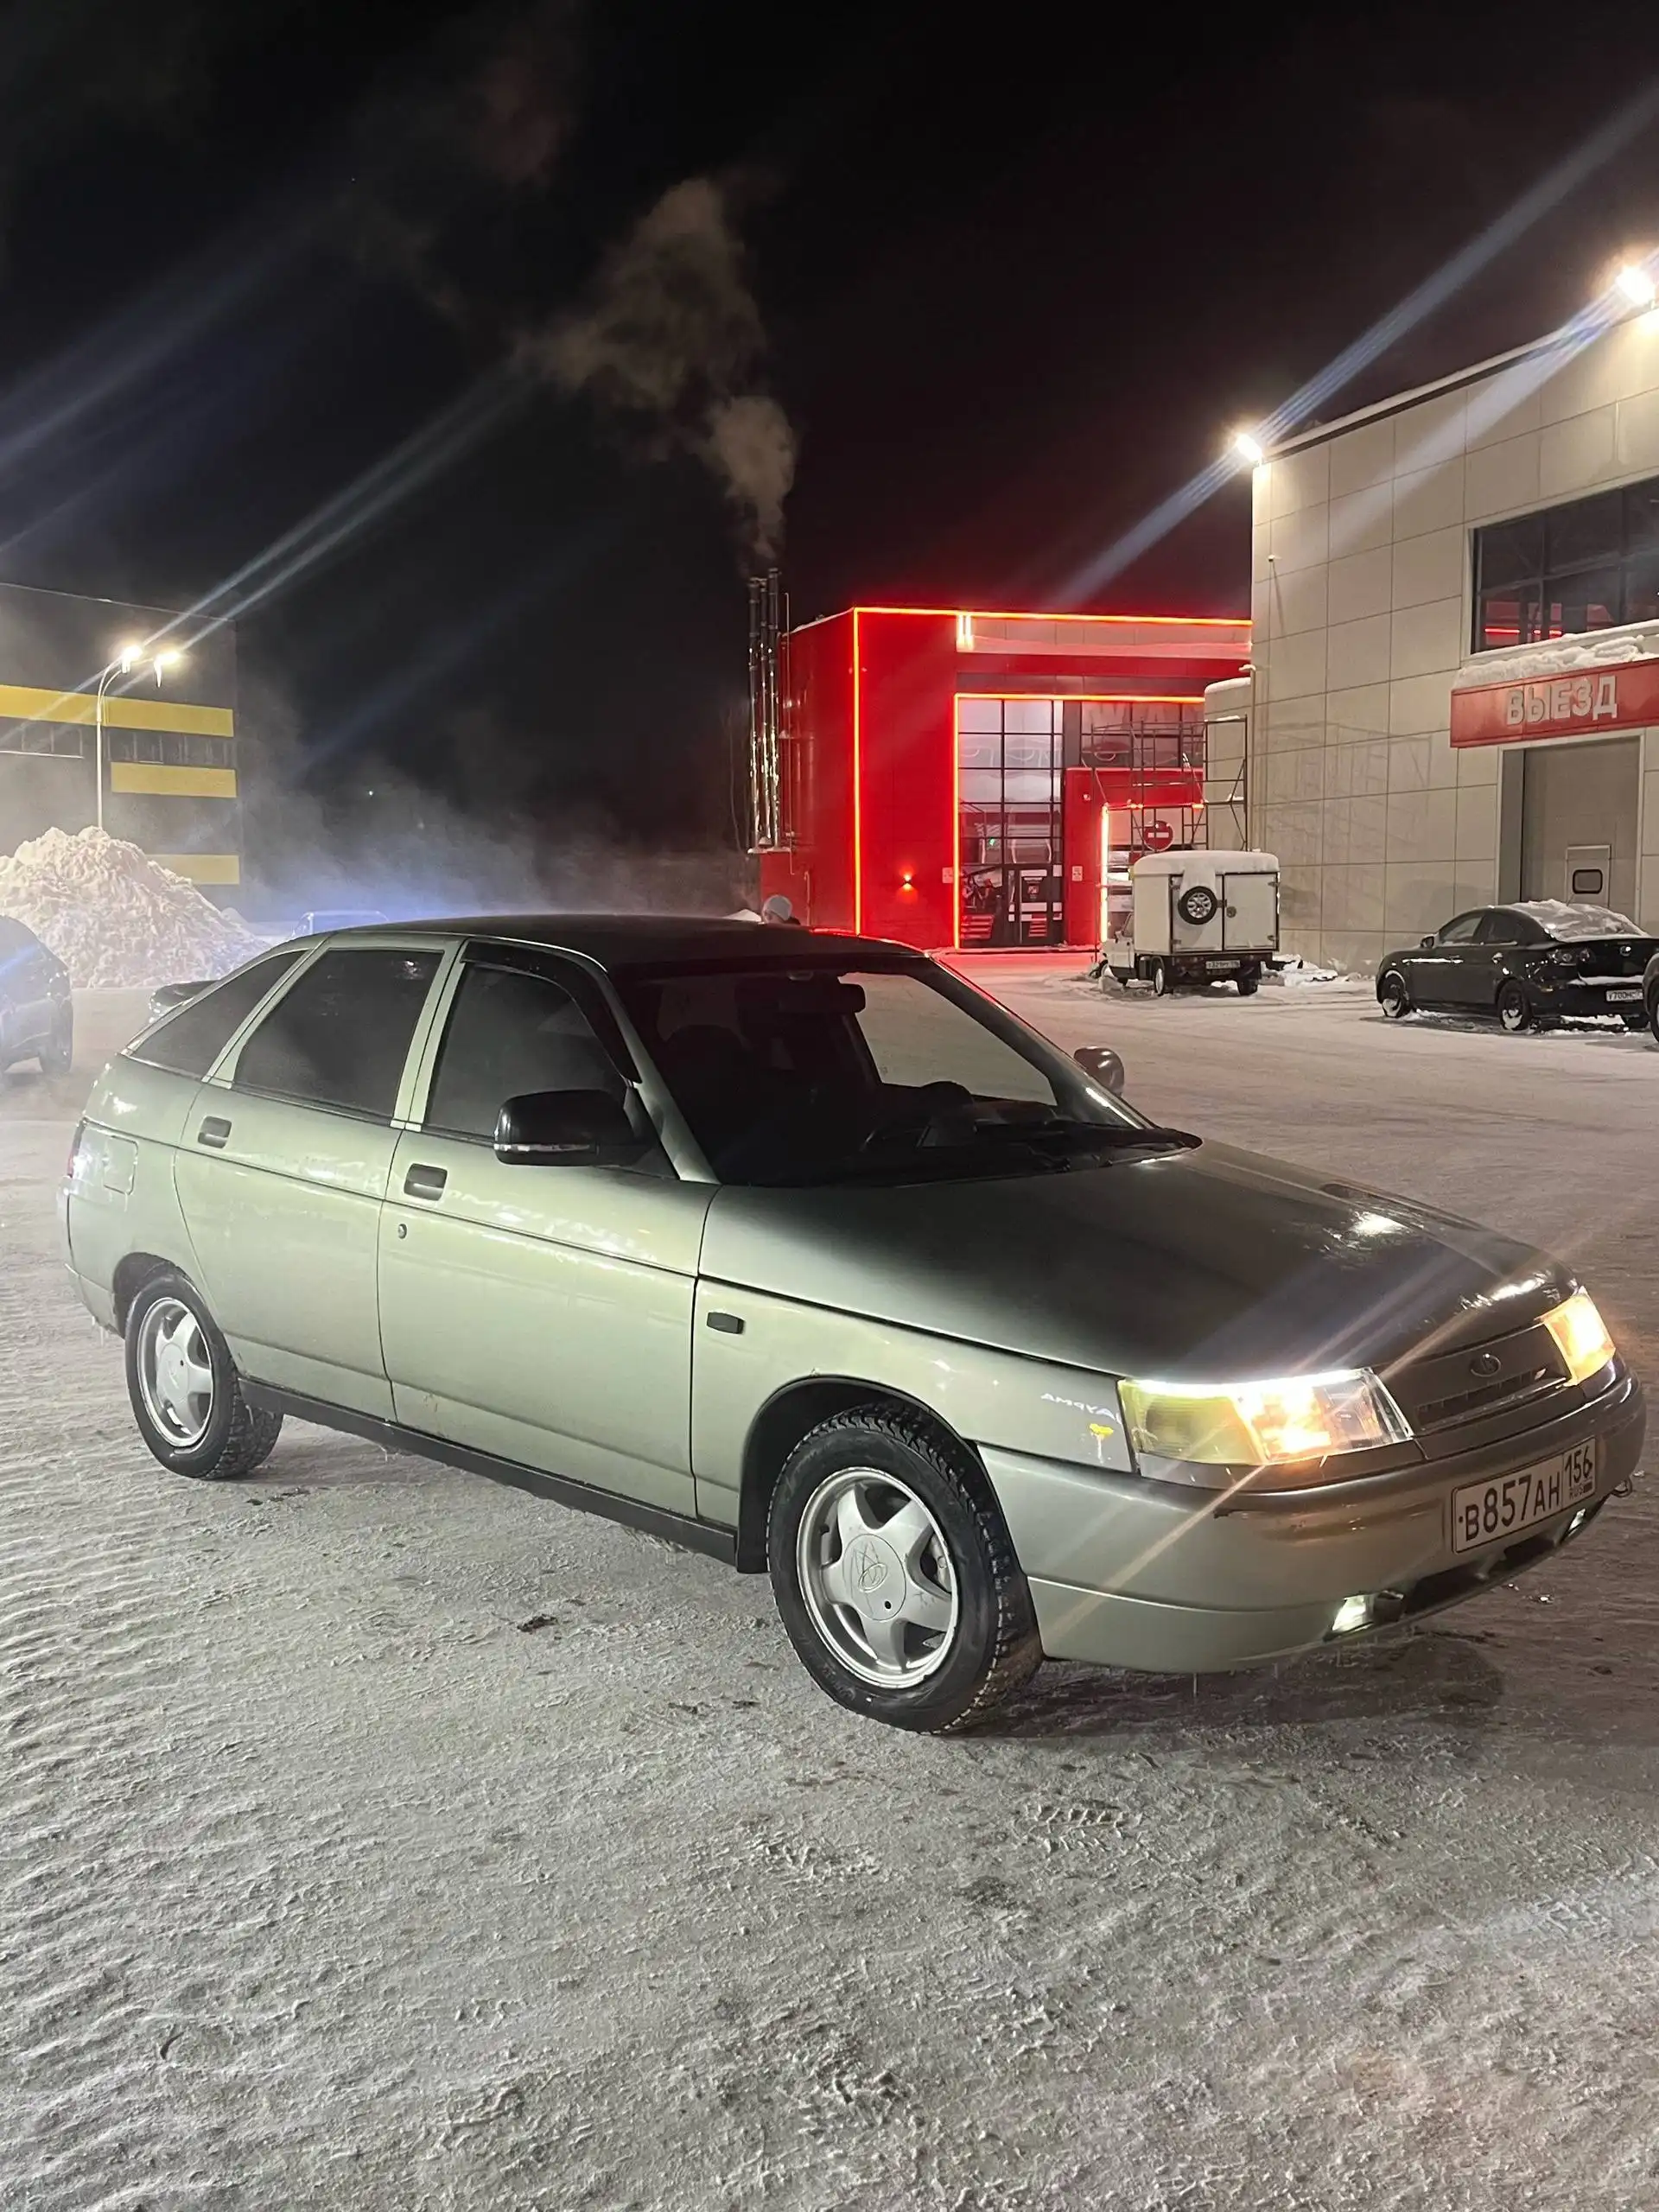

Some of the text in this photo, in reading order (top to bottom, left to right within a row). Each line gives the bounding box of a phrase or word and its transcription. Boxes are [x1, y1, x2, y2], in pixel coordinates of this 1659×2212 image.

[1506, 675, 1618, 726] ВЫЕЗД
[1465, 1445, 1593, 1541] В857АН 156
